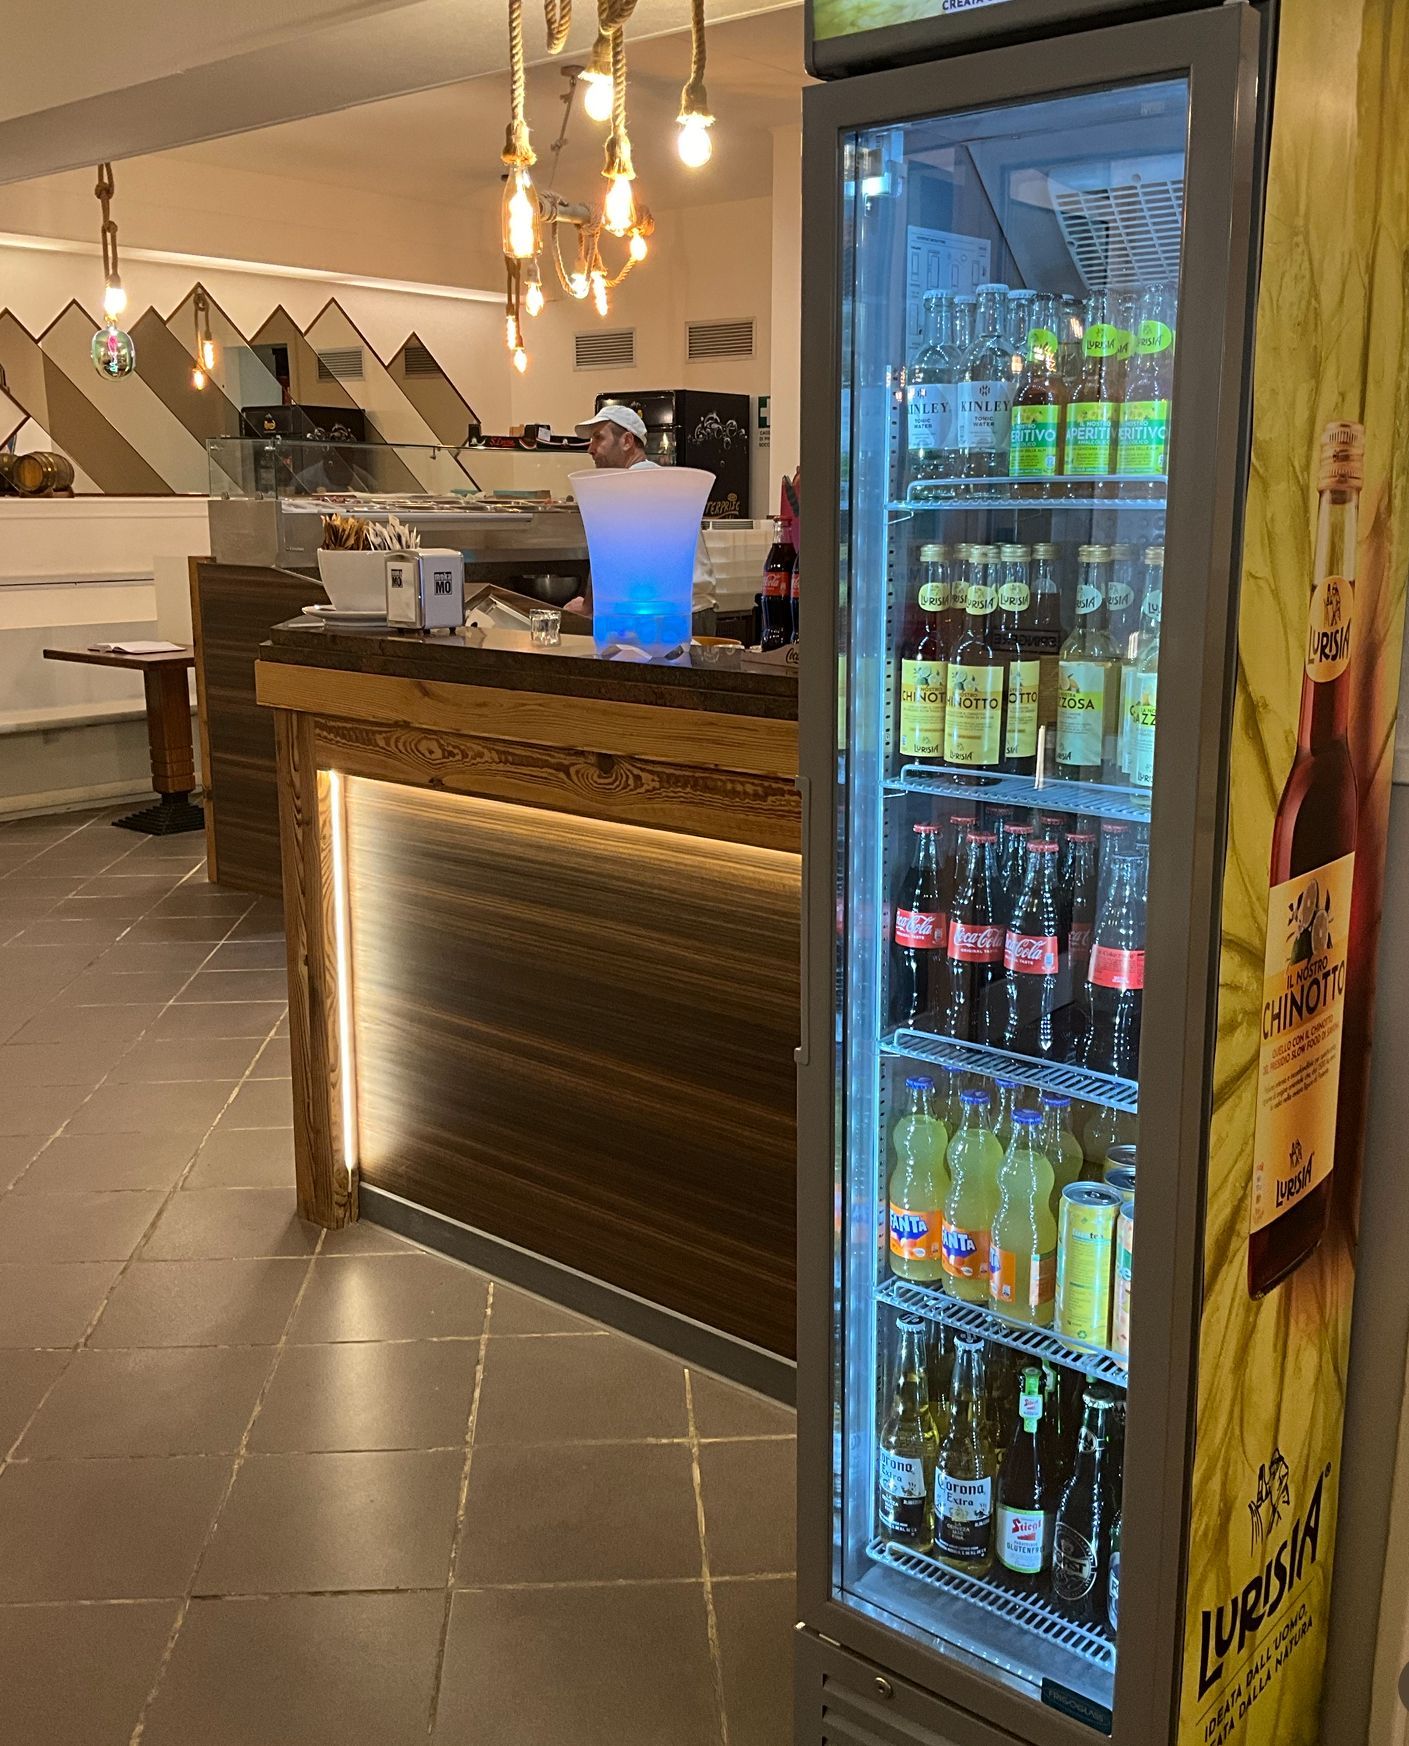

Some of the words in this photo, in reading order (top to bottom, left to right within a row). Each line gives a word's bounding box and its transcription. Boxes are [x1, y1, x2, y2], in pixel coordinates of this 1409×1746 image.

[961, 400, 1010, 412] KINLEY
[1011, 429, 1056, 442] ERITIVO
[435, 581, 451, 594] MO
[920, 594, 950, 606] LURISIA
[1307, 616, 1351, 665] LURISIA
[1287, 974, 1294, 990] IL
[1297, 955, 1328, 984] NOSTRO
[1263, 960, 1345, 1040] CHINOTTO
[1292, 1033, 1304, 1048] CON
[1307, 1033, 1320, 1051] FOOD
[1276, 1154, 1312, 1208] LURISIA
[947, 1493, 974, 1507] Extra
[1198, 1470, 1324, 1702] LURISIA
[1239, 1668, 1271, 1720] DALLA
[1276, 1615, 1312, 1672] NATURA
[1205, 1684, 1242, 1743] IDEATA
